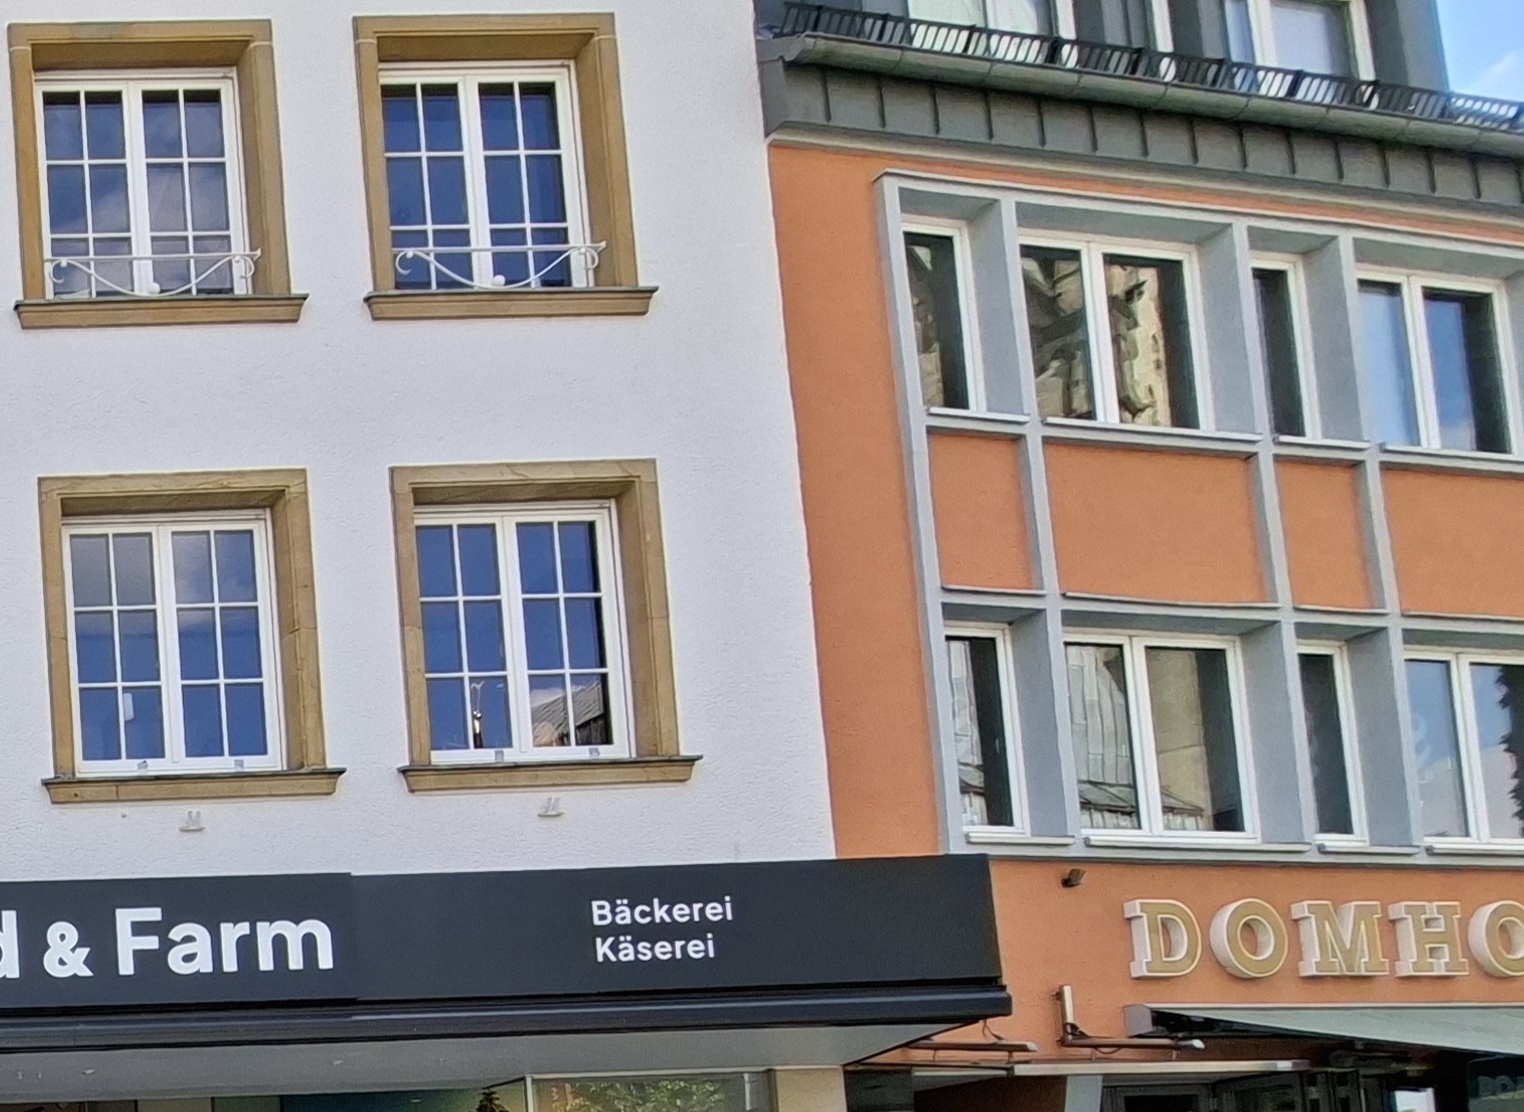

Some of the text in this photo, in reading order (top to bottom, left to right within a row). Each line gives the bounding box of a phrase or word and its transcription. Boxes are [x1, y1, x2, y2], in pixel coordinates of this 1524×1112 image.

[591, 895, 733, 926] Bäckerei
[42, 921, 94, 978] &
[114, 906, 335, 976] Farm
[595, 932, 715, 963] Käserei
